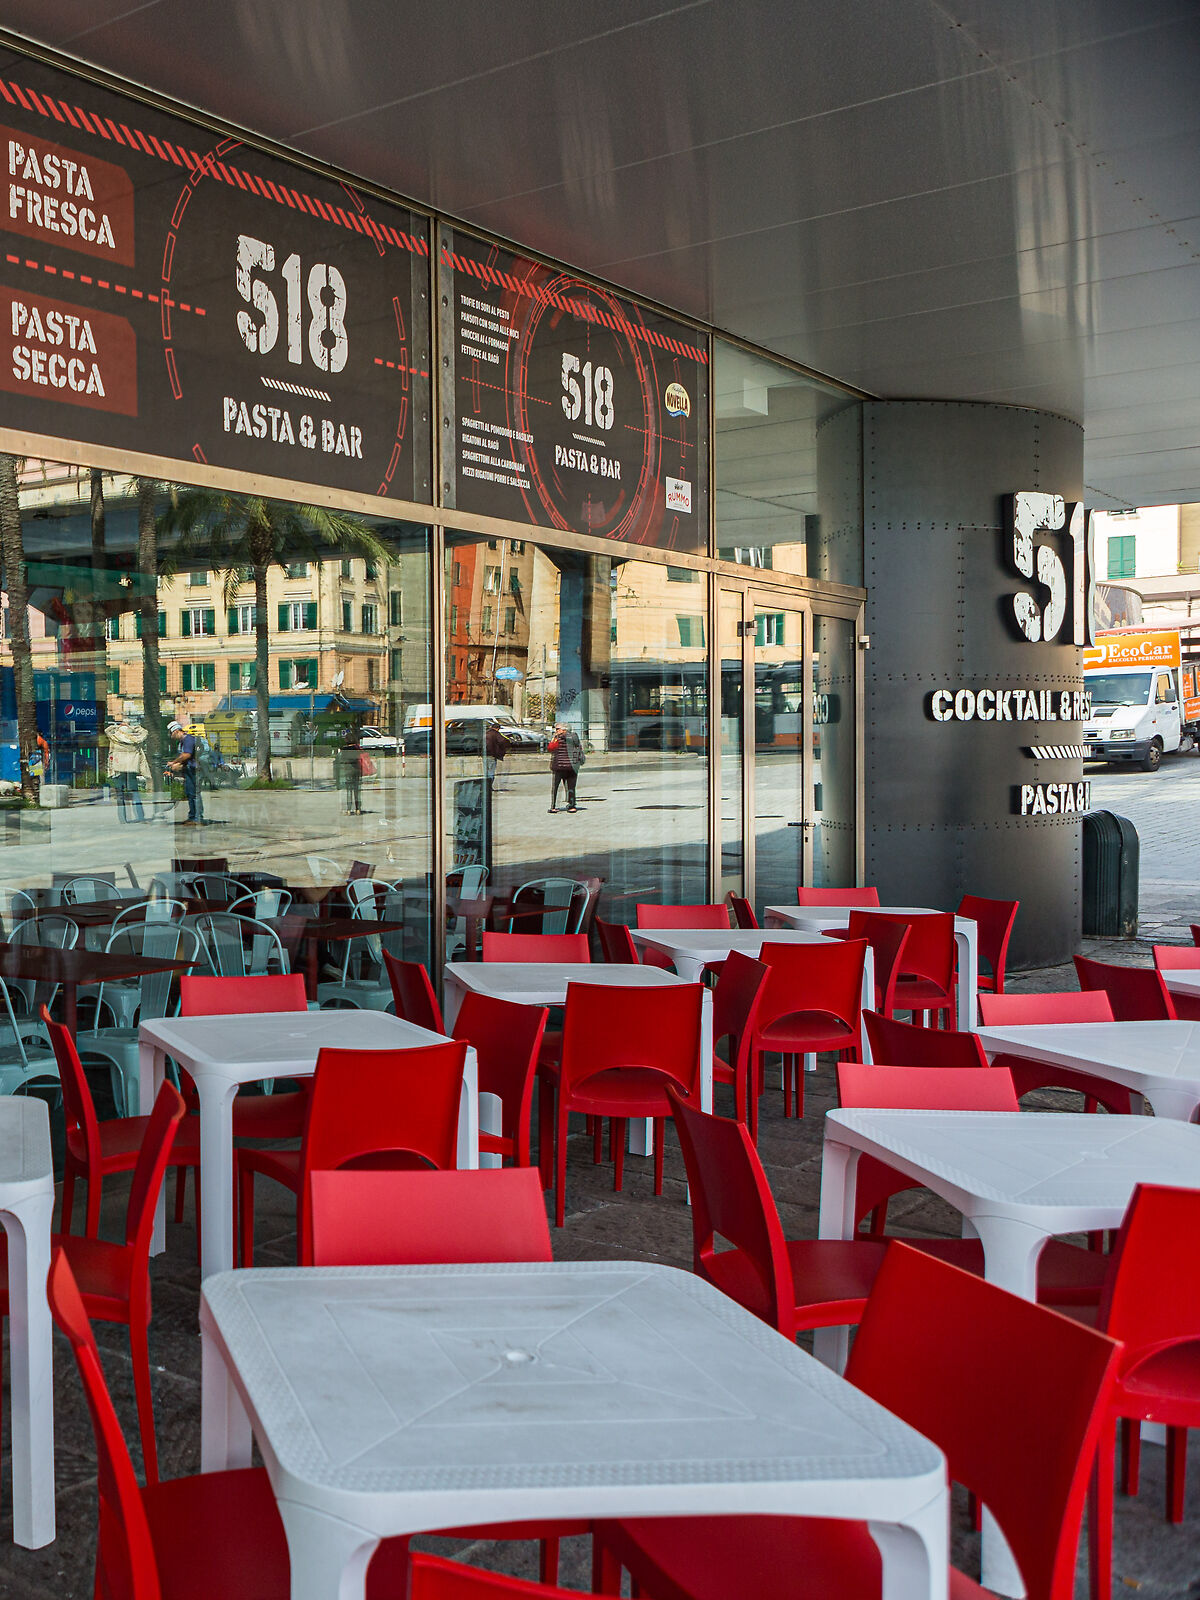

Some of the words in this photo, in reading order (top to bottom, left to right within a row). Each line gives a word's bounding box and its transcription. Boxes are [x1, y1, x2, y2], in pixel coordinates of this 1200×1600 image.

[8, 140, 95, 202] PASTA
[8, 183, 116, 249] FRESCA
[235, 234, 349, 374] 518
[461, 294, 475, 308] TROFIE
[476, 300, 480, 310] DI
[491, 305, 496, 316] AL
[497, 308, 509, 320] PESTO
[11, 301, 97, 355] PASTA
[460, 327, 480, 342] GNOCCHI
[488, 336, 509, 352] FORMAGGI
[479, 317, 488, 328] CON
[488, 320, 499, 332] SUGO
[499, 325, 510, 336] ALLE
[510, 328, 519, 339] NOCI
[461, 344, 482, 359] FETTUCCE
[482, 351, 488, 361] AL
[12, 345, 106, 397] SECCA
[561, 352, 615, 431] 518
[222, 396, 295, 442] PASTA
[298, 420, 318, 450] &
[321, 419, 364, 460] BAR
[461, 416, 485, 431] SPAGHETTI
[485, 422, 490, 432] AL
[490, 424, 513, 438] POMODORO
[516, 431, 534, 444] BASILICO
[461, 433, 481, 446] RIGATONI
[481, 438, 487, 448] AL
[461, 449, 490, 465] SPAGHETTONI
[490, 456, 501, 467] ALLA
[501, 458, 526, 473] CARBONARA
[555, 444, 588, 472] PASTA
[590, 454, 600, 475] &
[601, 457, 621, 480] BAR
[462, 466, 474, 477] MEZZI
[475, 468, 494, 481] RIGATONI
[510, 476, 531, 490] SALSICCIA
[667, 492, 690, 507] RUMMO
[1012, 490, 1095, 647] 51
[1108, 641, 1173, 658] EcoCar
[76, 707, 97, 717] pepsi
[931, 688, 1057, 722] COCKTAIL
[1059, 690, 1072, 721] &
[1021, 783, 1076, 816] PASTA
[1076, 782, 1085, 812] &
